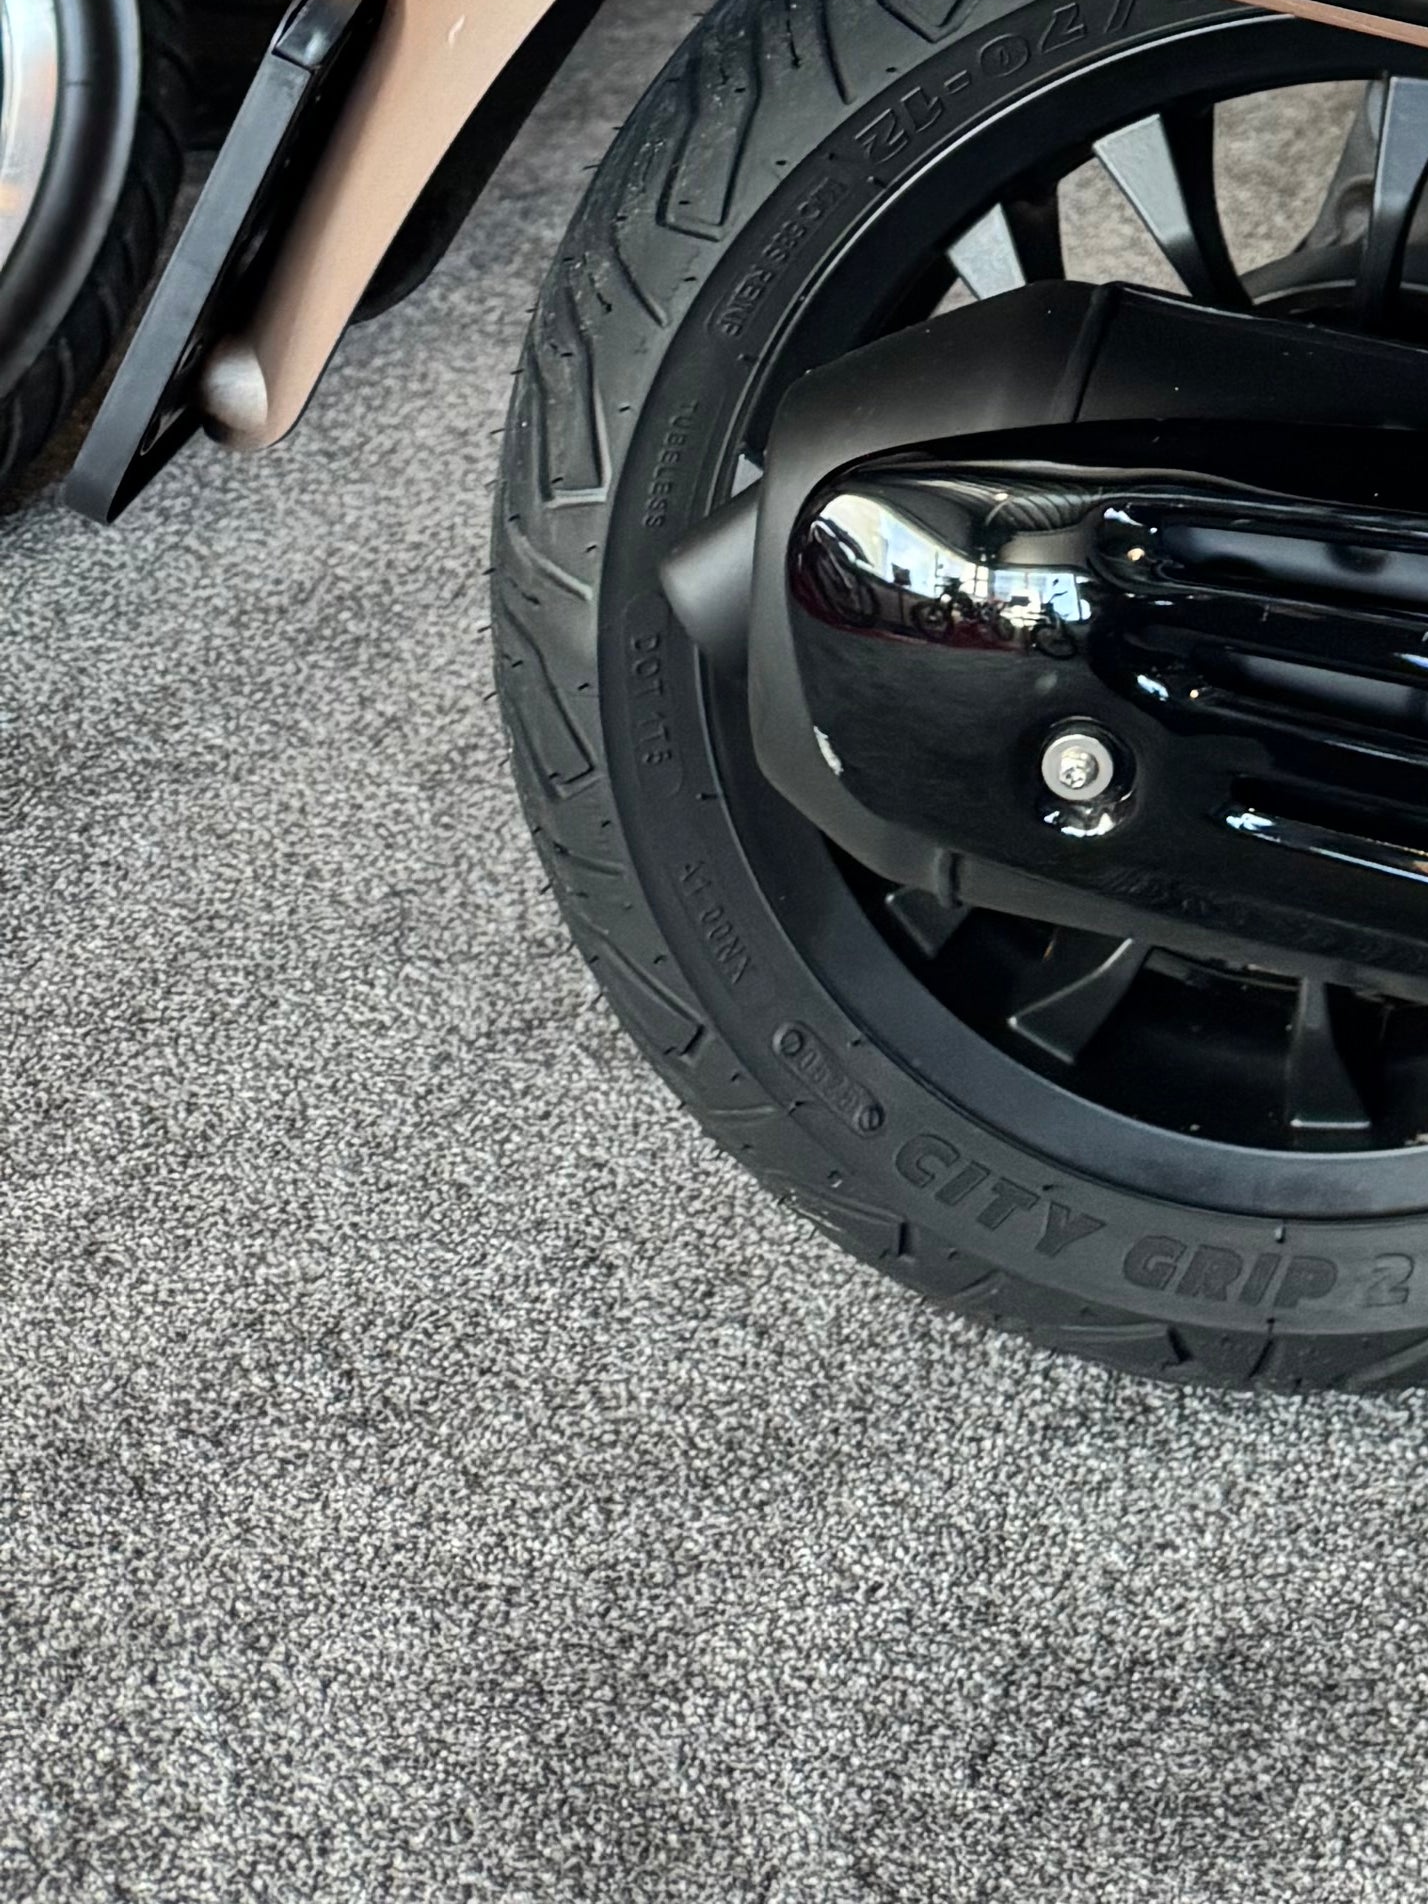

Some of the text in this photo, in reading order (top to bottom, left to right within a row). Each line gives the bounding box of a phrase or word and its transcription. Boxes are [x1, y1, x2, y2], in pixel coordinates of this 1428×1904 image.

[641, 400, 699, 528] TUBELESS
[630, 632, 665, 697] DOT
[894, 1133, 1416, 1308] CITY GRIP 2
